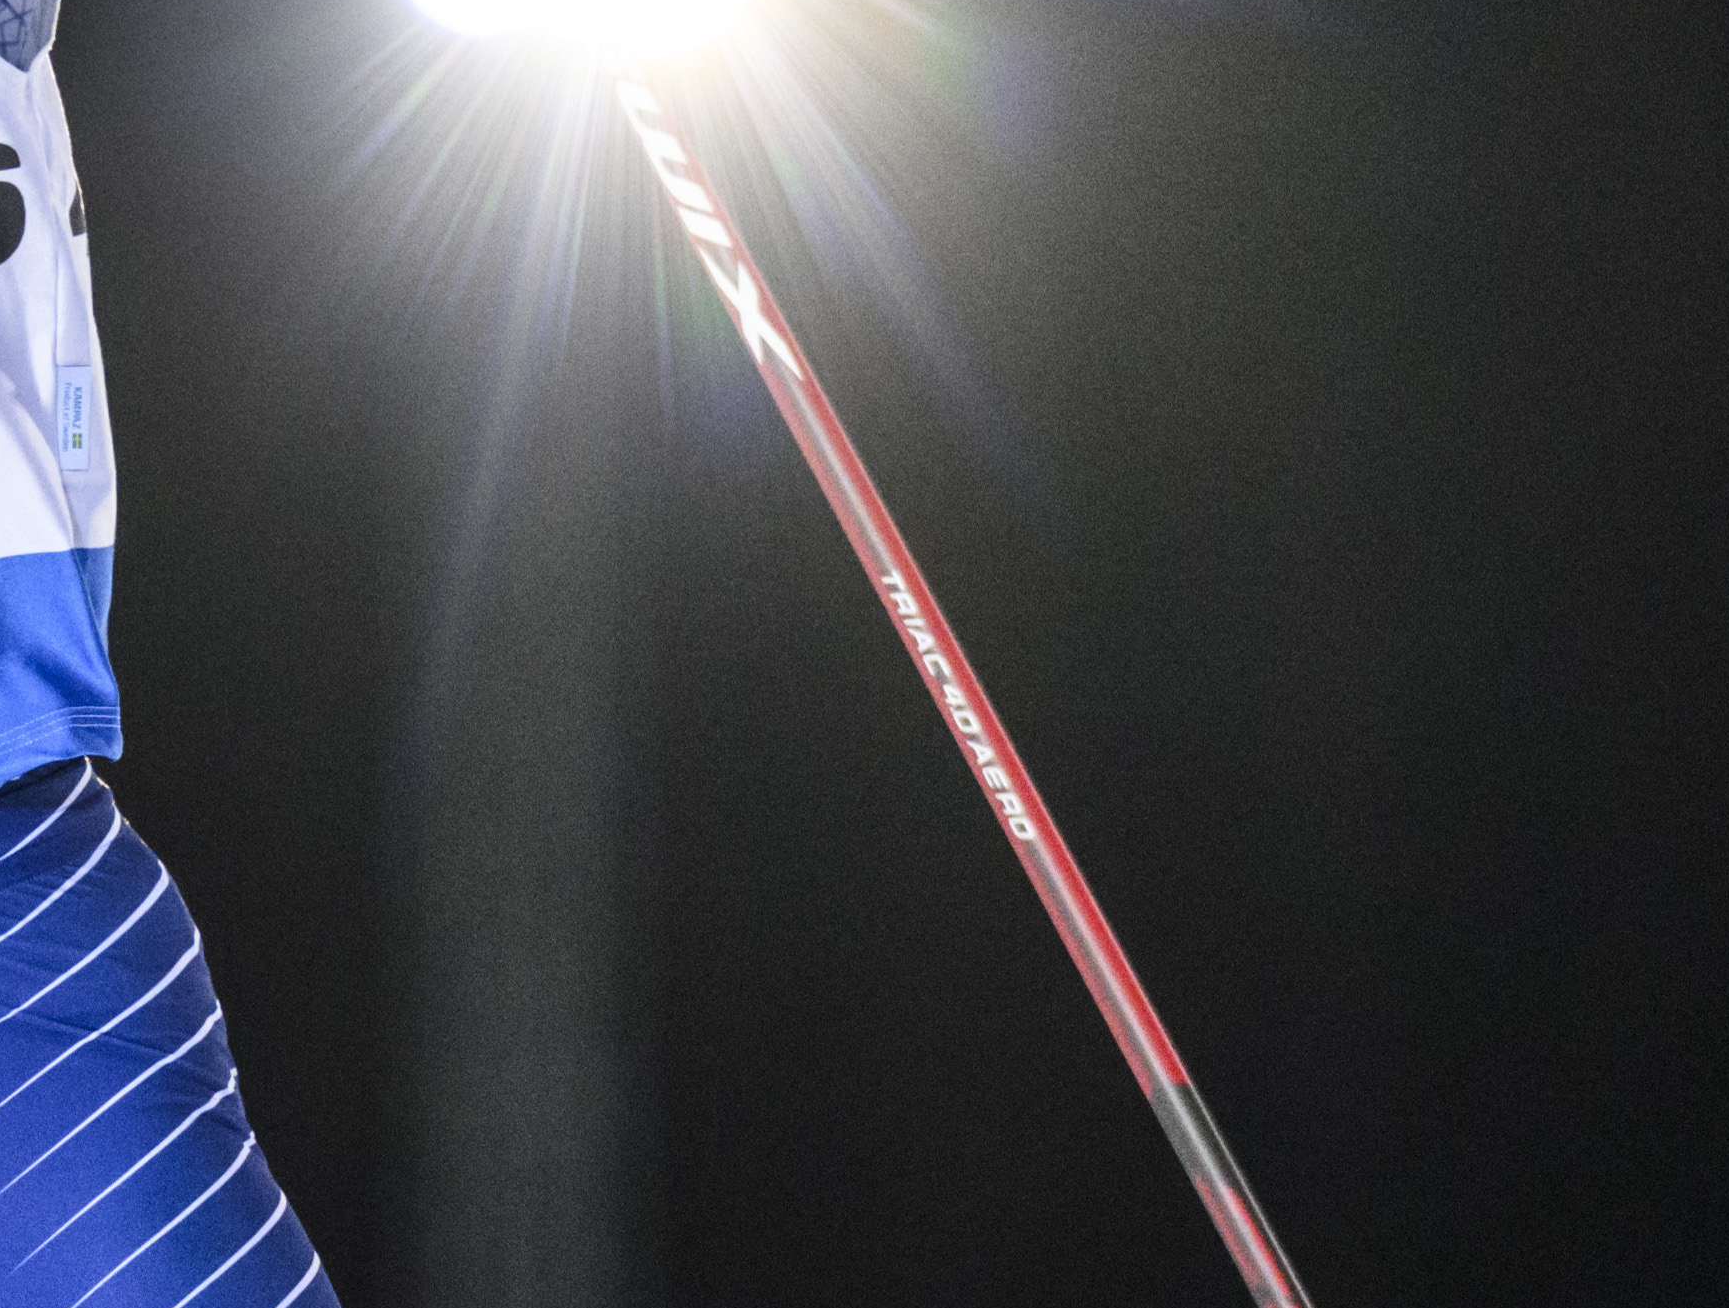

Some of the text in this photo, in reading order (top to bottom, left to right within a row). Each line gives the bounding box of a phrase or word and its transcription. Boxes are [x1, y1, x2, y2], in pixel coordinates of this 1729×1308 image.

[615, 77, 805, 382] WIX
[881, 568, 952, 679] TRIAC
[966, 739, 1036, 841] AERO
